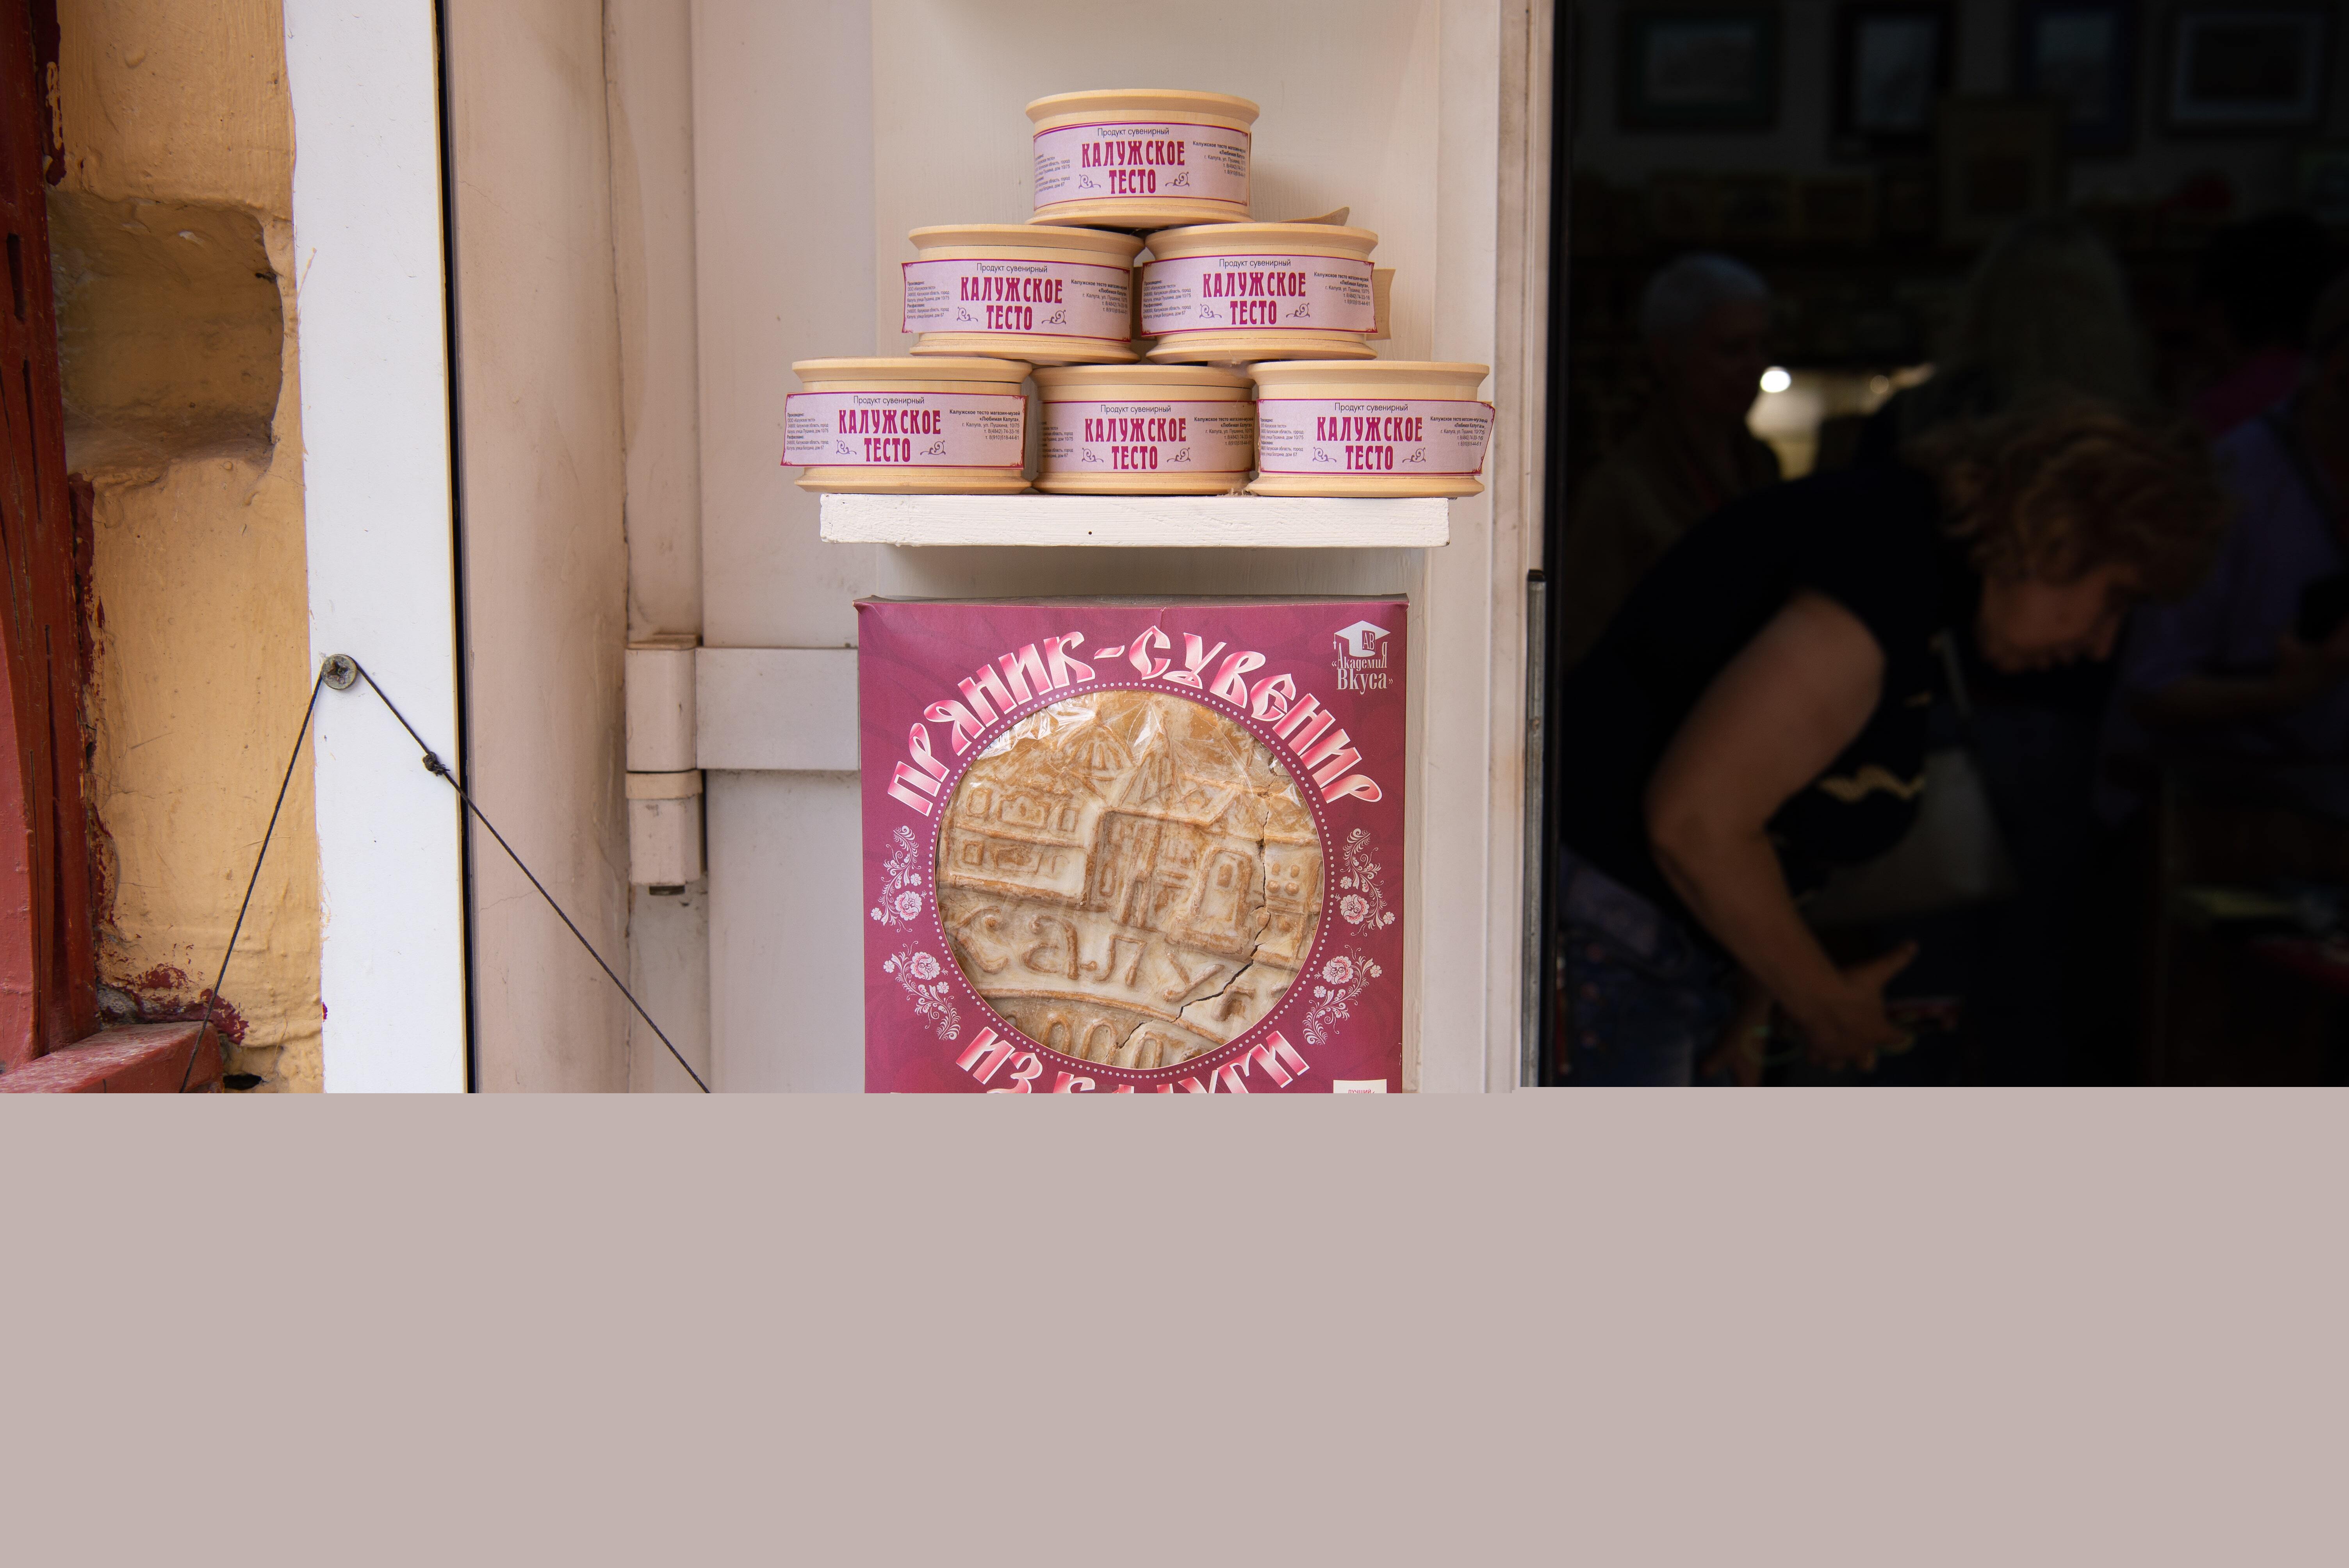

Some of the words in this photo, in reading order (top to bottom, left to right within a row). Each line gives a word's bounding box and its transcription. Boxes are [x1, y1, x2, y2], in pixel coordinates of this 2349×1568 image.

[1098, 128, 1125, 138] Продукт
[1128, 128, 1169, 137] сувенирный
[1082, 141, 1185, 168] КАЛУЖСКОЕ
[1109, 169, 1156, 194] ТЕСТО
[977, 263, 1005, 273] Продукт
[1006, 265, 1048, 274] сувенирный
[1219, 259, 1248, 269] Продукт
[1250, 259, 1291, 269] сувенирный
[961, 277, 1062, 304] КАЛУЖСКОЕ
[1203, 272, 1306, 298] КАЛУЖСКОЕ
[986, 305, 1032, 330] ТЕСТО
[1230, 301, 1277, 325] ТЕСТО
[854, 396, 881, 406] Продукт
[883, 397, 925, 406] сувенирный
[1101, 405, 1129, 415] Продукт
[1130, 405, 1171, 415] сувенирный
[1335, 403, 1365, 413] Продукт
[1367, 404, 1408, 413] сувенирный
[839, 410, 941, 434] КАЛУЖСКОЕ
[1085, 418, 1186, 442] КАЛУЖСКОЕ
[1317, 417, 1422, 442] КАЛУЖСКОЕ
[864, 438, 911, 462] ТЕСТО
[1112, 446, 1158, 470] ТЕСТО
[1346, 445, 1393, 470] ТЕСТО
